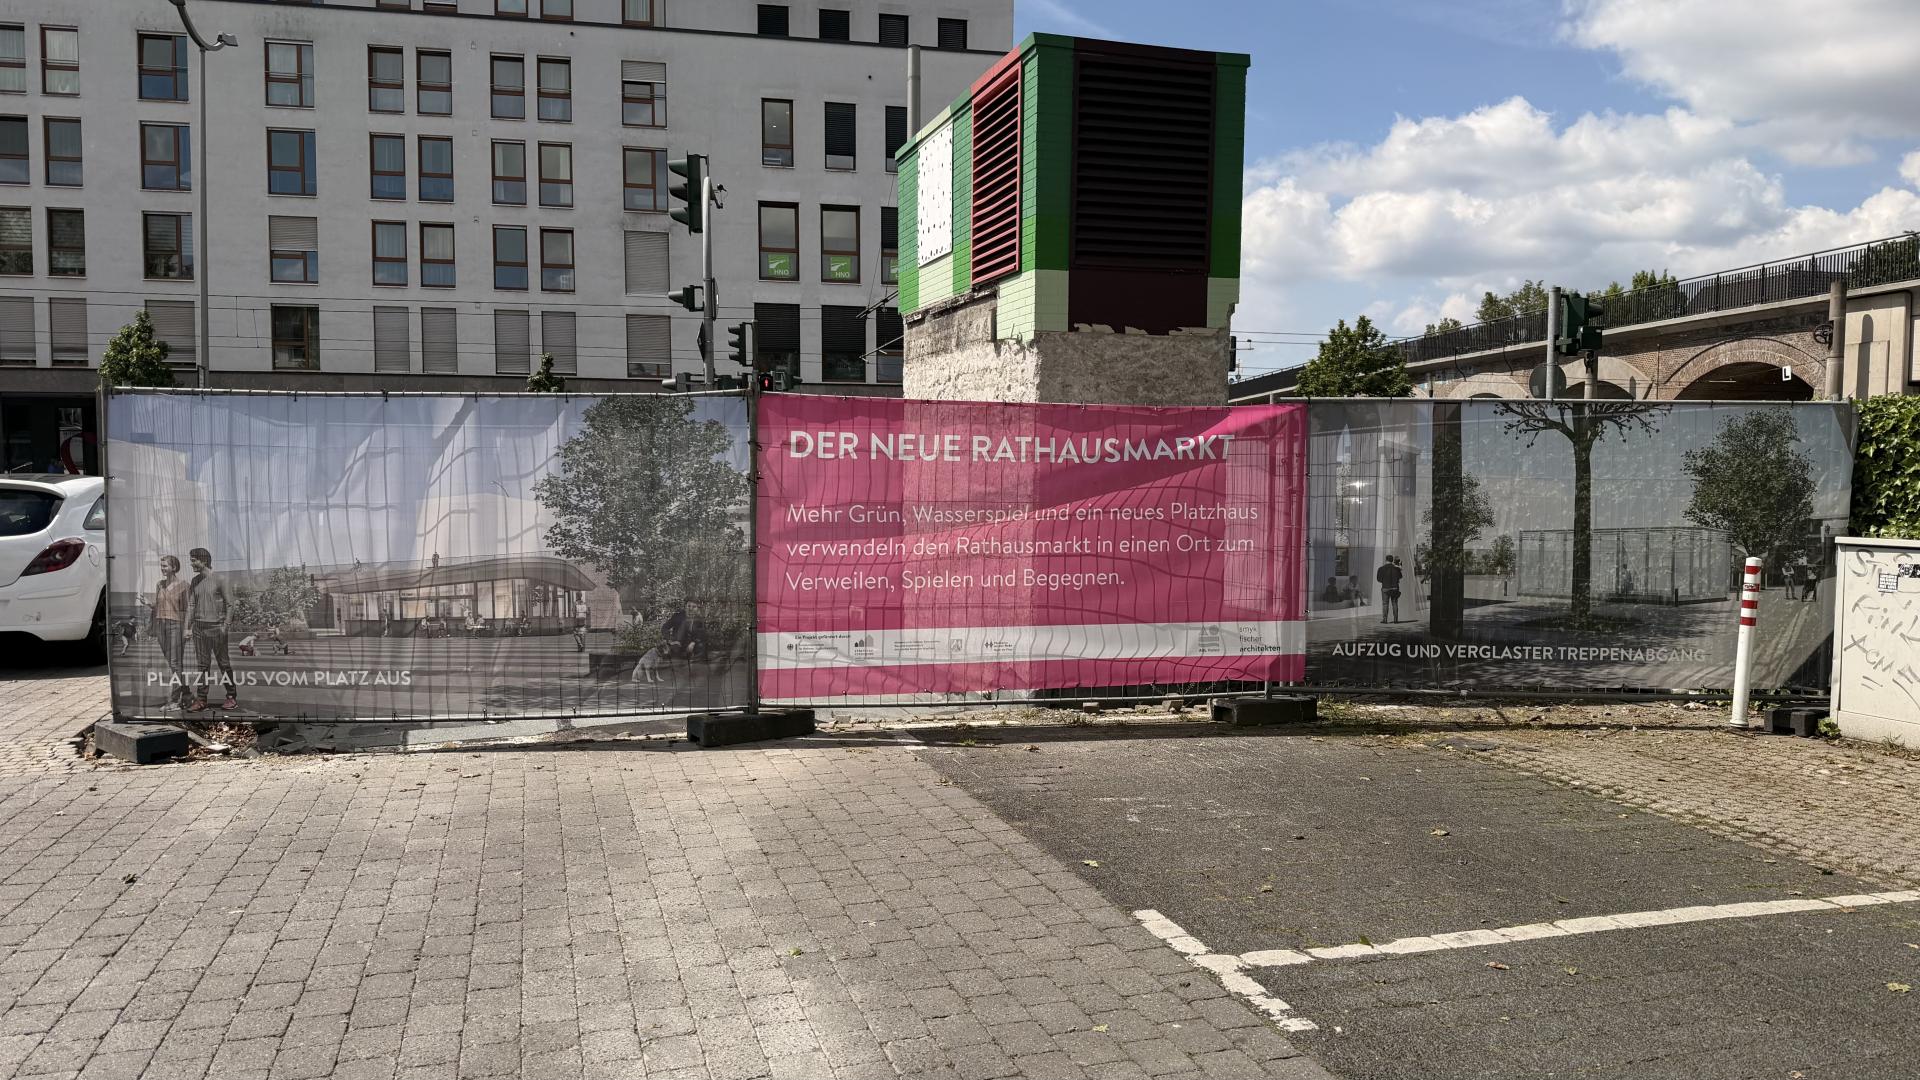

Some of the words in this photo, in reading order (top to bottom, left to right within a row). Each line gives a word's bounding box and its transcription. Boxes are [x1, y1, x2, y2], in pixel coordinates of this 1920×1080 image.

[1783, 367, 1790, 379] L
[790, 430, 858, 460] DER
[870, 432, 961, 462] NEUE
[972, 434, 1235, 464] RATHAUSMARKT
[787, 503, 842, 523] Mehr
[848, 505, 907, 526] Grün,
[912, 505, 1029, 526] Wasserspiel
[1035, 504, 1070, 521] und
[1076, 503, 1104, 521] ein
[1110, 508, 1164, 520] neues
[1171, 502, 1258, 520] Platzhaus
[786, 538, 906, 556] verwandeln
[913, 537, 949, 556] den
[956, 536, 1091, 554] Rathausmarkt
[1097, 536, 1113, 553] in
[1119, 536, 1170, 553] einen
[1176, 534, 1211, 552] Ort
[1216, 538, 1254, 552] zum
[786, 570, 895, 593] Verweilen,
[901, 569, 974, 594] Spielen
[980, 569, 1017, 588] und
[1023, 568, 1125, 591] Begegnen.
[1239, 644, 1281, 652] architekten
[1332, 642, 1401, 657] AUFZUG
[1406, 644, 1441, 658] UND
[1445, 645, 1553, 660] VERGLASTER
[1557, 646, 1706, 662] TREPPENABGANG
[147, 671, 257, 687] PLATZHAUS
[262, 671, 308, 686] VOM
[314, 671, 370, 686] PLATZ
[373, 670, 411, 686] AUS
